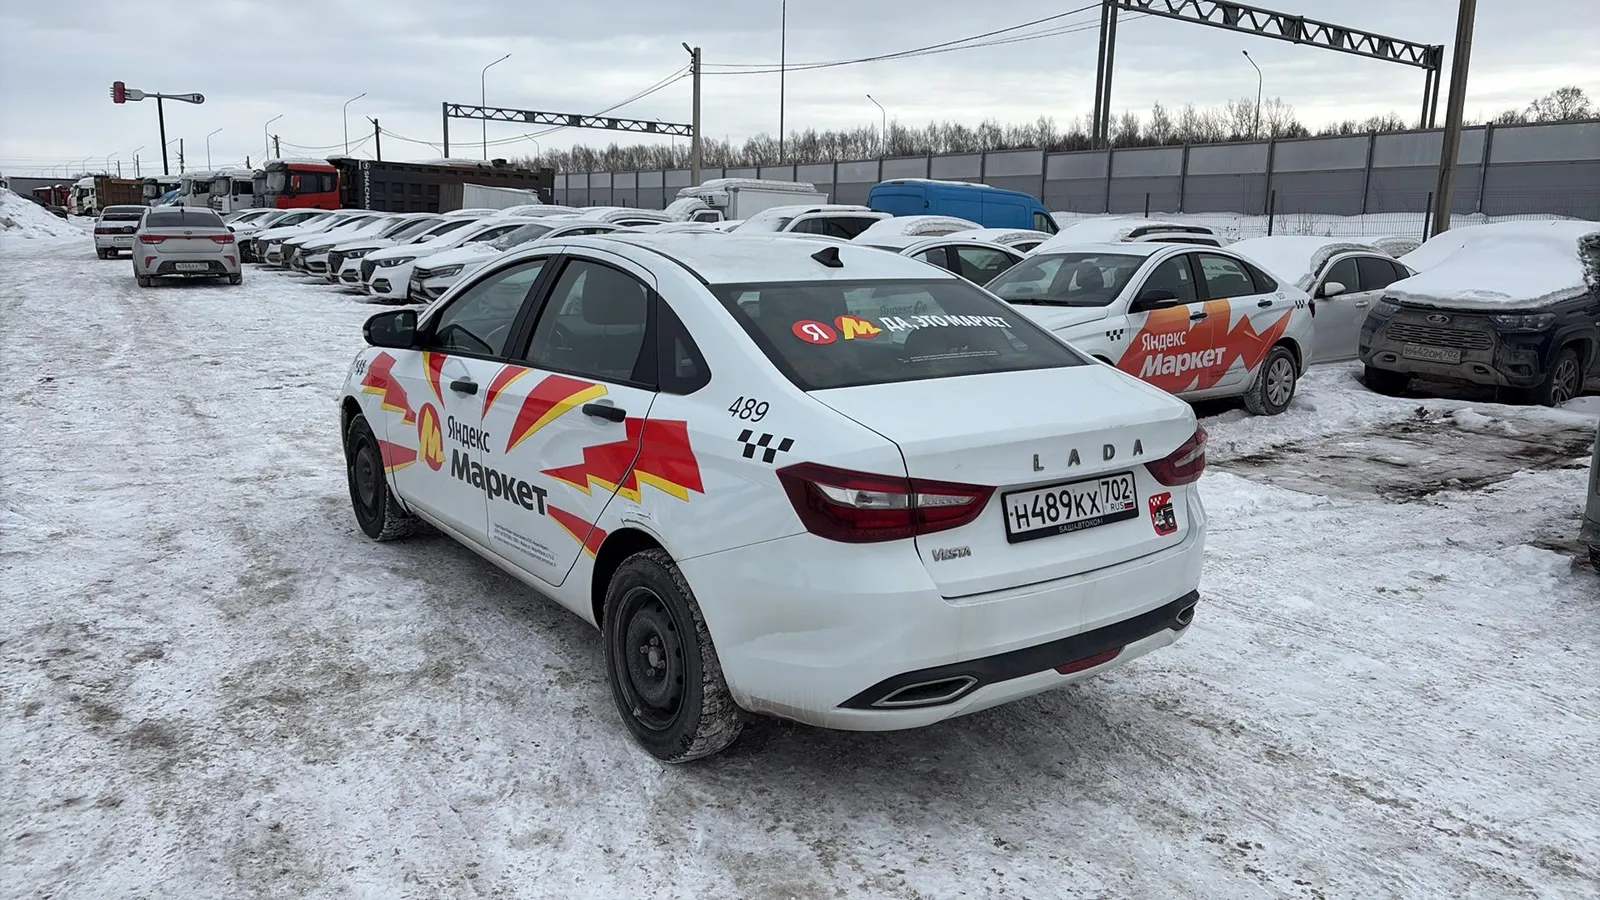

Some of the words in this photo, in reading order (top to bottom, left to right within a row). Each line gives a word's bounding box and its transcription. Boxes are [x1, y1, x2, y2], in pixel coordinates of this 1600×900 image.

[801, 324, 829, 341] Я
[914, 315, 948, 329] ЭТО
[946, 315, 1012, 328] МАРКЕТ
[1141, 331, 1186, 351] Яндекс
[1139, 347, 1226, 378] Маркет
[728, 396, 769, 422] 489
[448, 415, 490, 453] Яндекс
[1033, 439, 1144, 472] LADA
[451, 449, 547, 516] Маркет
[1101, 478, 1131, 503] 702
[1110, 501, 1124, 511] RUS
[932, 546, 971, 561] VESTA
